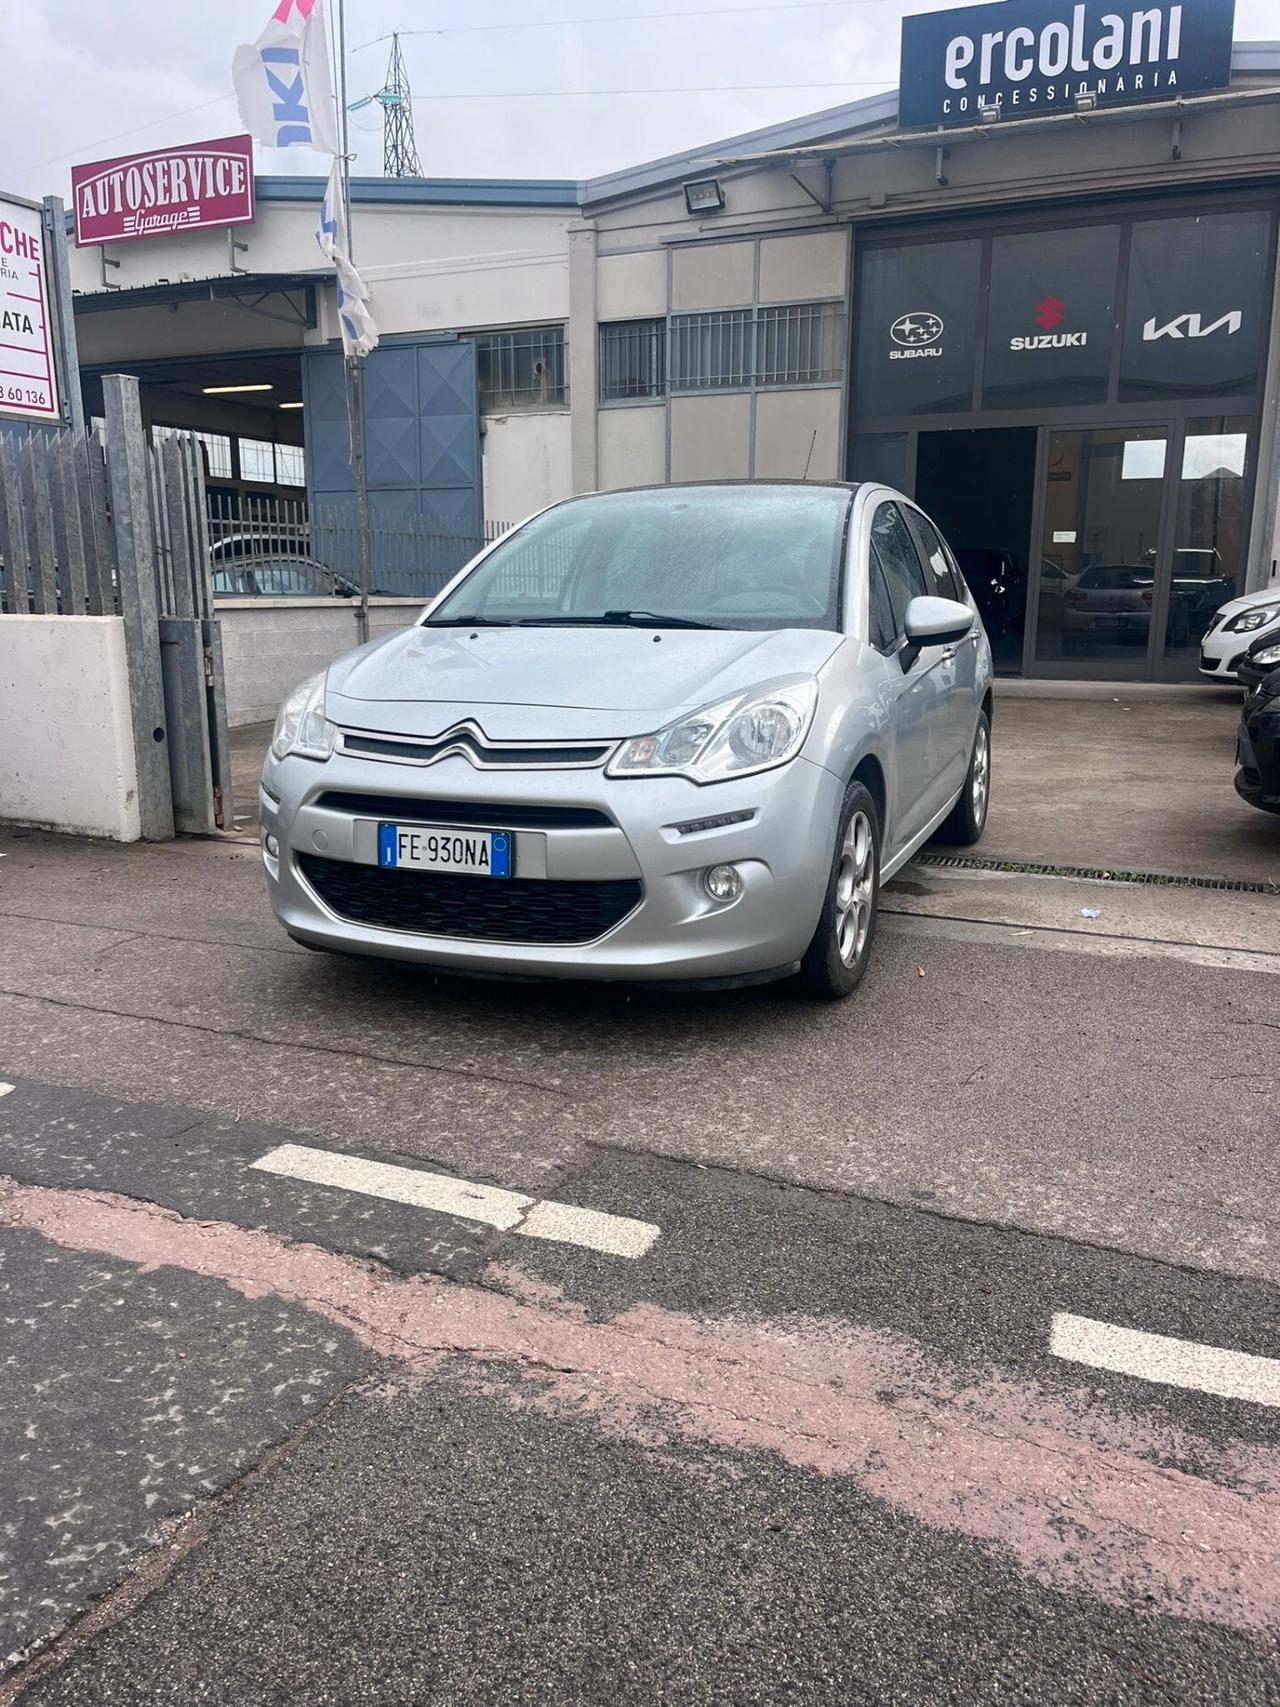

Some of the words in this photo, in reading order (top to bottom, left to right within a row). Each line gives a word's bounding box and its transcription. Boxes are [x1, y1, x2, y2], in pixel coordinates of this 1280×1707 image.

[945, 4, 1182, 90] ercolani
[943, 70, 1177, 114] CONCESSIONARIA
[82, 158, 245, 218] AUTOSERVICE
[135, 209, 189, 235] Garage
[0, 221, 40, 261] CHE
[0, 310, 34, 335] ATA
[1143, 310, 1242, 341] KIA
[889, 348, 942, 360] SUBARU
[1010, 332, 1087, 351] SUZUKI
[8, 387, 23, 401] 60
[26, 389, 46, 405] 136
